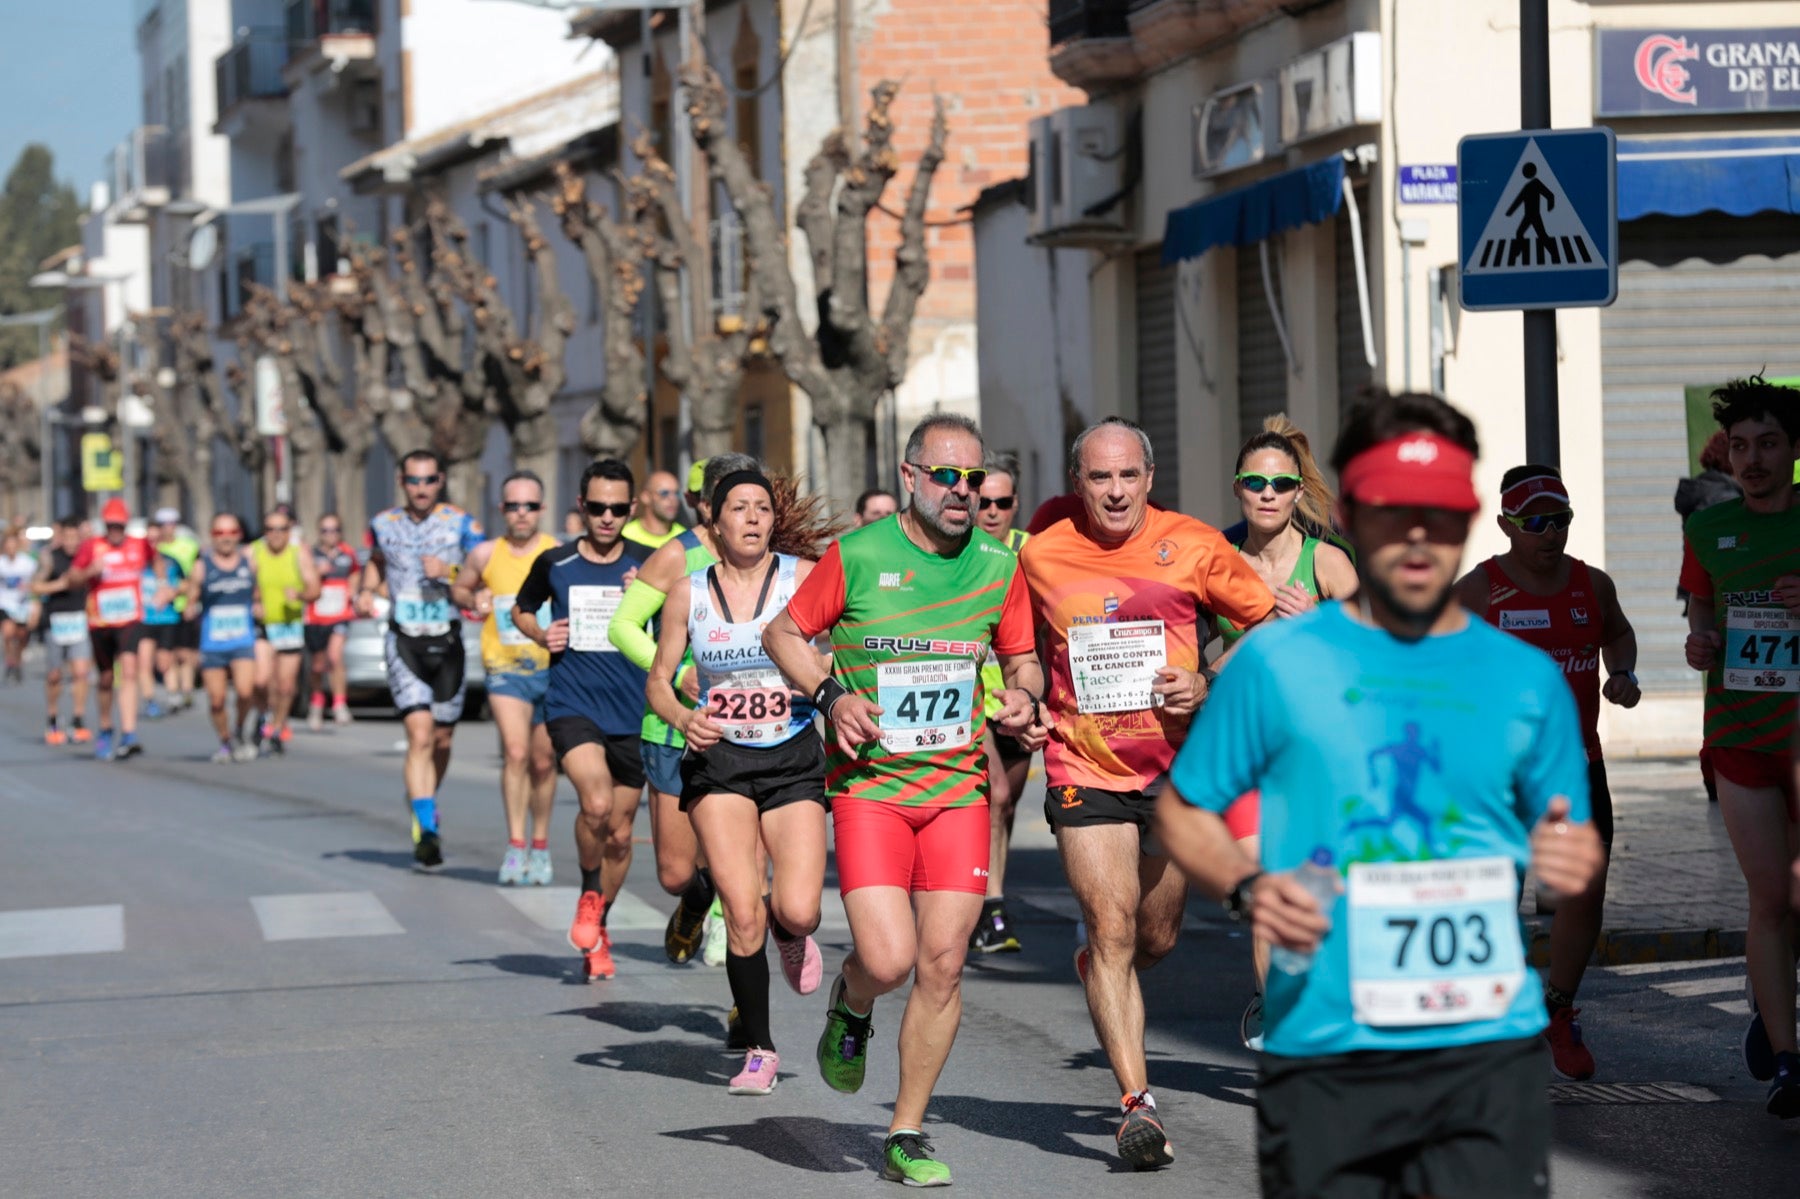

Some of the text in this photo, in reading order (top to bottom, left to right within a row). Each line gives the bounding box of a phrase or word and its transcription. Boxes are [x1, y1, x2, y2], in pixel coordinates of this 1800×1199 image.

[1729, 67, 1766, 91] DE
[1411, 166, 1449, 180] PLAZA
[708, 626, 731, 642] als
[1072, 649, 1163, 663] YO CORRO CONTRA
[1740, 634, 1800, 665] 471
[903, 665, 920, 674] GRAN
[921, 664, 943, 673] PREMIO
[944, 663, 952, 671] DE
[953, 662, 971, 671] FONDO
[1105, 661, 1144, 670] CANCER
[912, 674, 948, 684] DIPUTACIÓN
[1089, 674, 1123, 686] aecc
[711, 691, 787, 719] 2283
[896, 688, 960, 723] 472
[1387, 914, 1492, 968] 703
